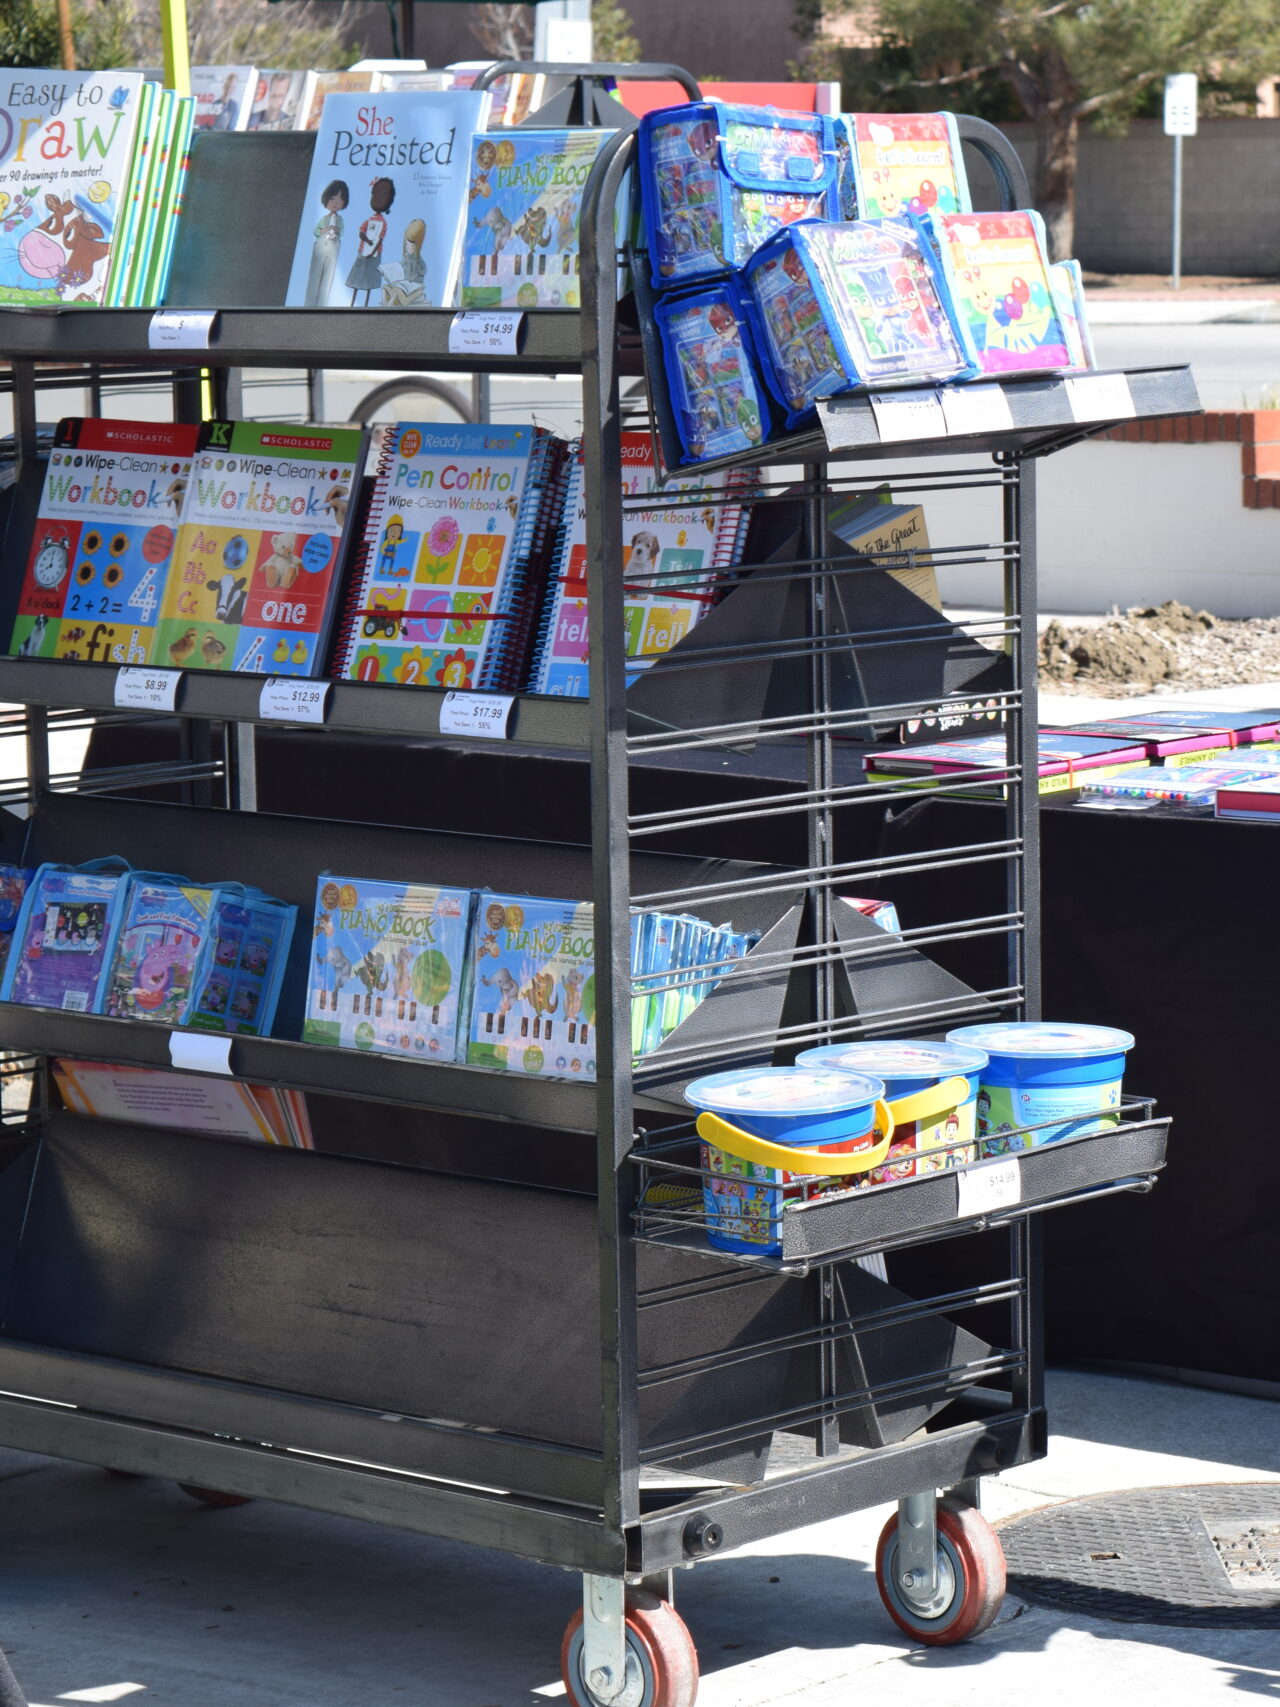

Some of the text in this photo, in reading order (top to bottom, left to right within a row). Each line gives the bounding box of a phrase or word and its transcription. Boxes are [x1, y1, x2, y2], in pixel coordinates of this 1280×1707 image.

[8, 82, 103, 116] Easy to
[356, 106, 394, 136] She
[328, 127, 456, 166] Persisted
[9, 164, 103, 183] 90 drawings to master!
[497, 161, 548, 193] PIANO
[484, 322, 513, 334] $14.99
[489, 338, 503, 346] 50%
[64, 420, 75, 441] 1
[113, 432, 174, 444] SCHOLASTIC
[209, 422, 231, 445] K
[271, 436, 332, 449] SCHOLASTIC
[425, 433, 463, 452] Ready
[484, 435, 516, 450] Learn
[620, 444, 651, 461] eady
[85, 454, 158, 473] Wipe-Clean
[240, 458, 316, 479] Wipe-Clean
[394, 463, 518, 492] Pen Control
[48, 474, 162, 509] Workbook
[198, 479, 320, 517] Workbook
[449, 496, 502, 511] Workbook
[641, 511, 698, 525] Workbook
[891, 516, 920, 549] Great
[70, 594, 81, 612] 2
[99, 597, 109, 614] 2
[128, 568, 157, 622] 4
[261, 600, 307, 625] one
[560, 617, 589, 643] tel
[647, 621, 684, 649] tell
[87, 623, 145, 664] fish
[145, 680, 167, 690] $8.99
[404, 660, 419, 685] 2
[447, 663, 462, 688] 3
[292, 691, 319, 702] $12.99
[473, 706, 502, 719] $17.99
[340, 909, 437, 943] PIANO BOOK
[506, 927, 594, 958] PIANO BOO
[990, 1172, 1015, 1187] $14.99
